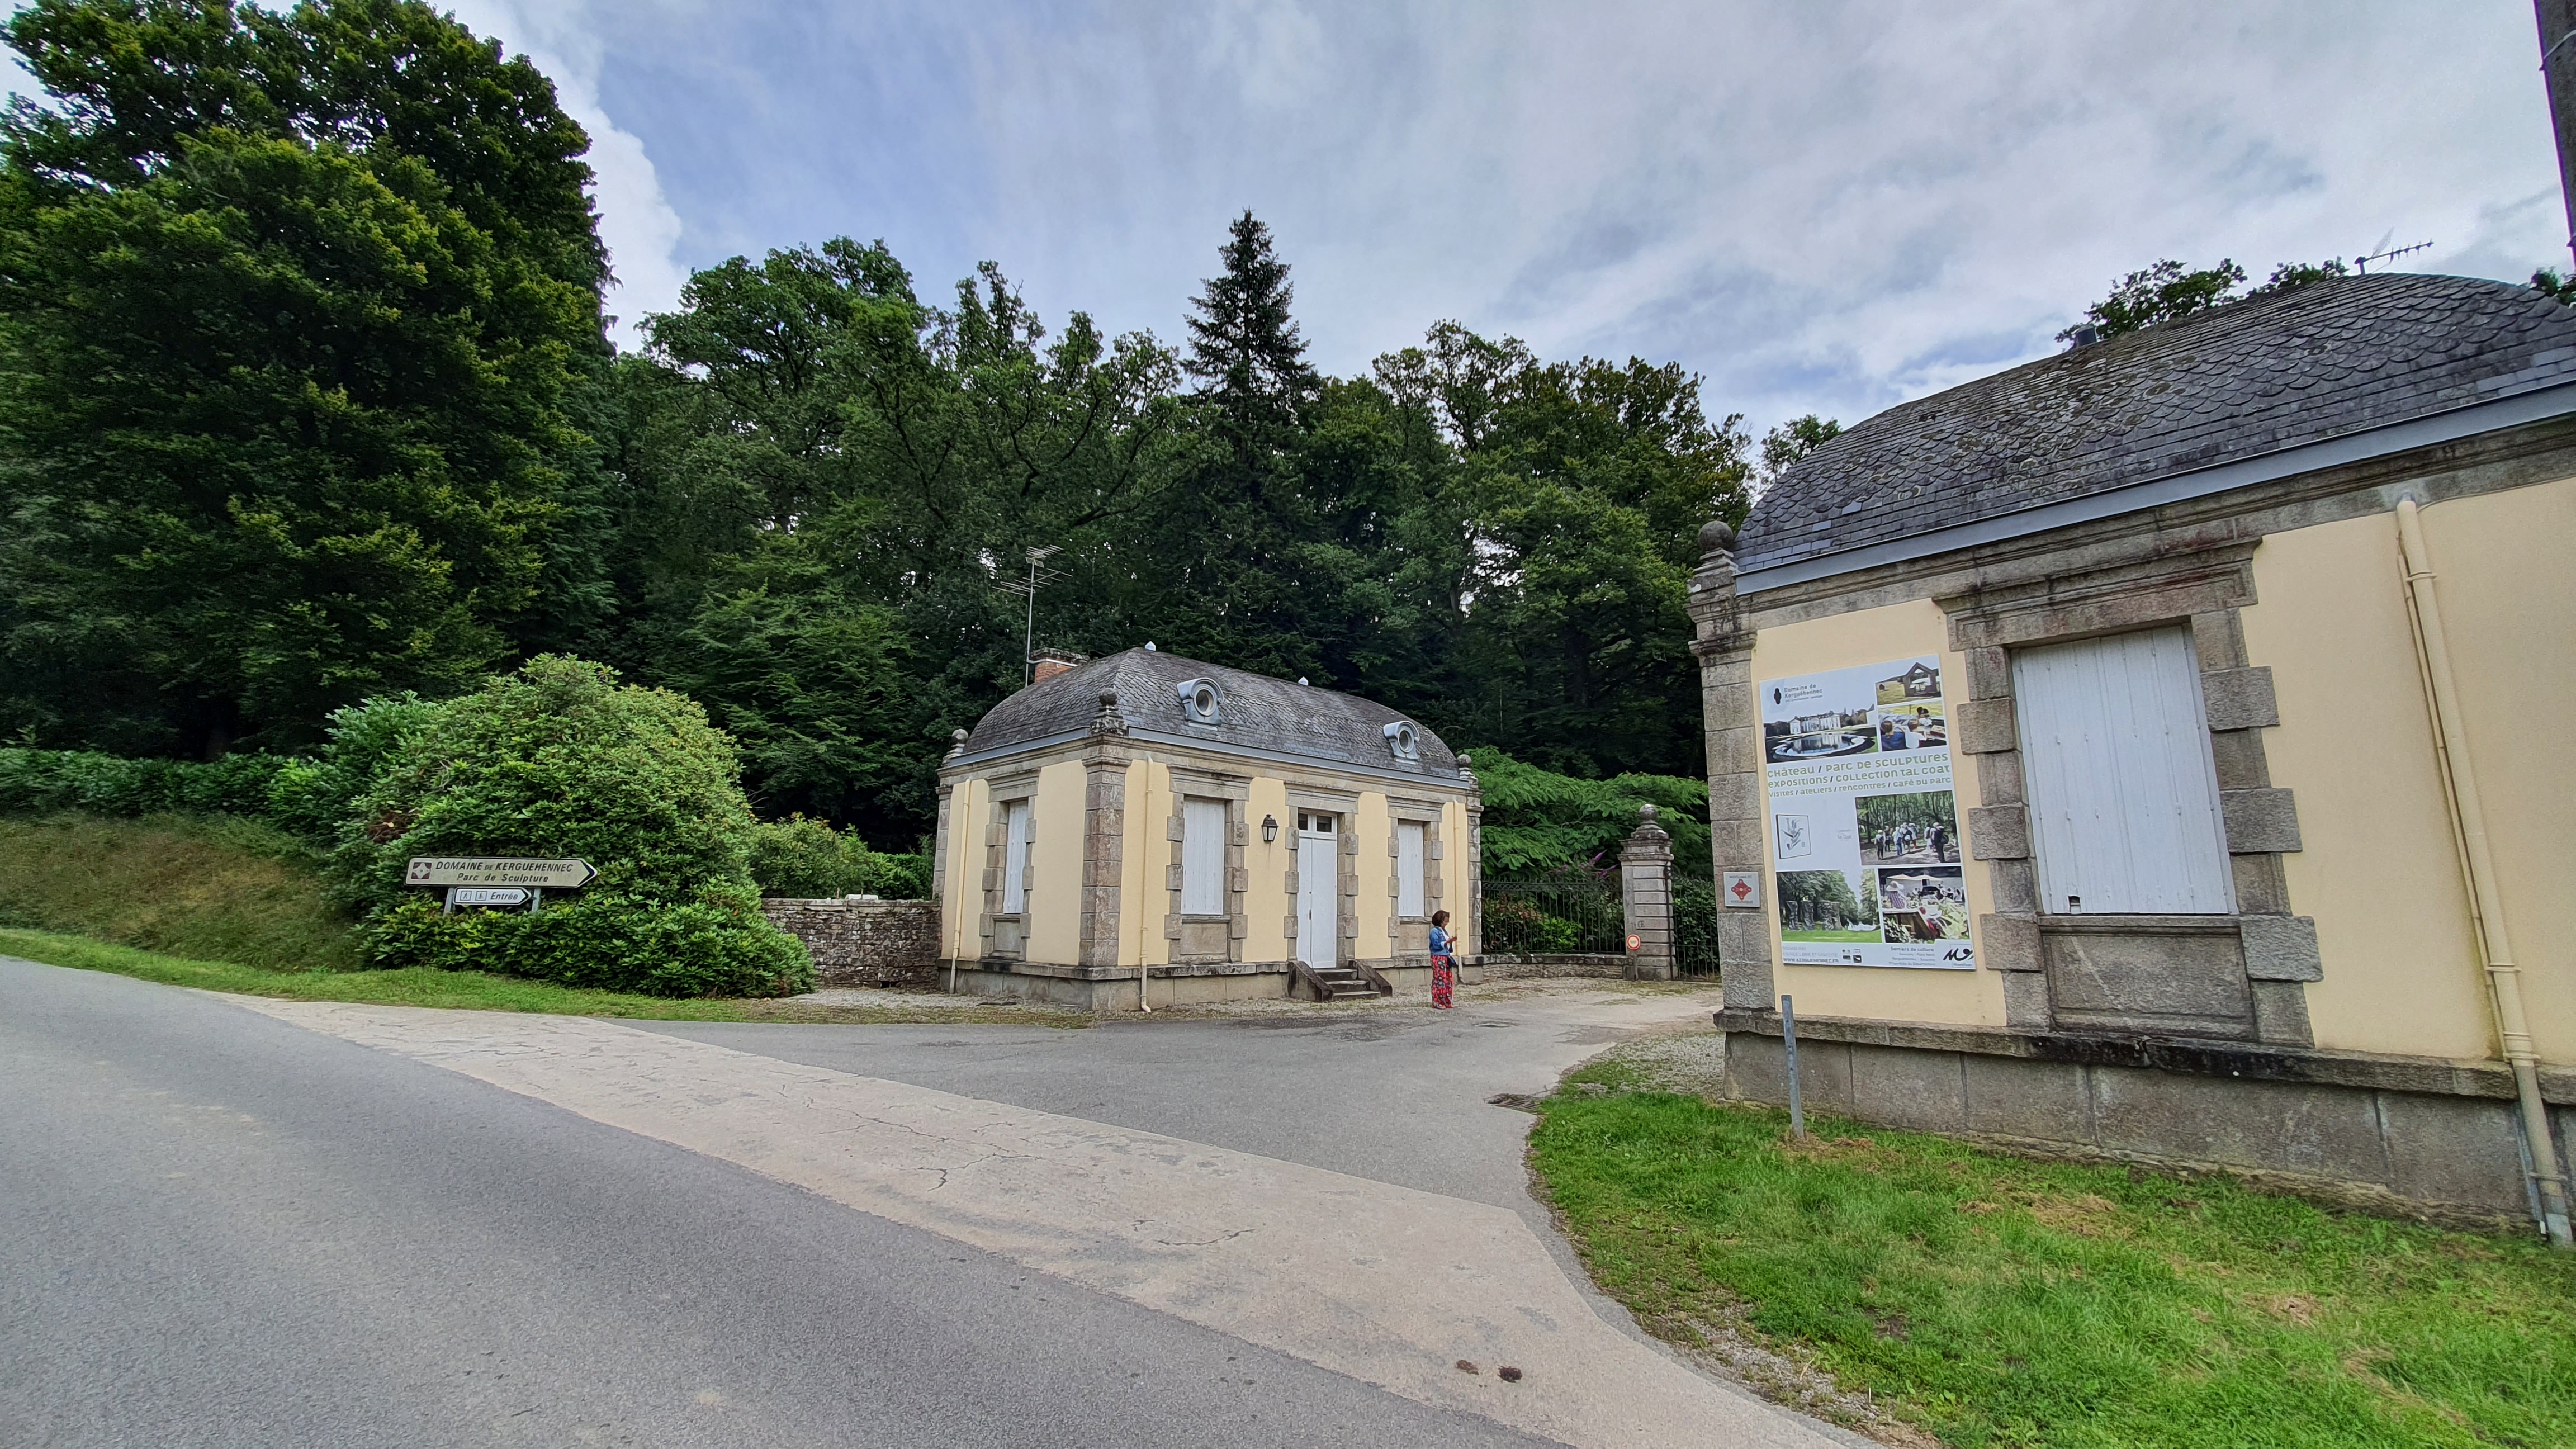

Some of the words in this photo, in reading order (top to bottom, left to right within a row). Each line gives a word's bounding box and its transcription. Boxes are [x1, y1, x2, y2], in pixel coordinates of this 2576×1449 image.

[435, 861, 484, 870] DOMAINE
[495, 862, 573, 872] KERGUEHENNEC
[457, 873, 479, 881] Parc
[484, 873, 496, 881] de
[501, 874, 549, 883] Sculpture
[490, 892, 518, 901] Entrée
